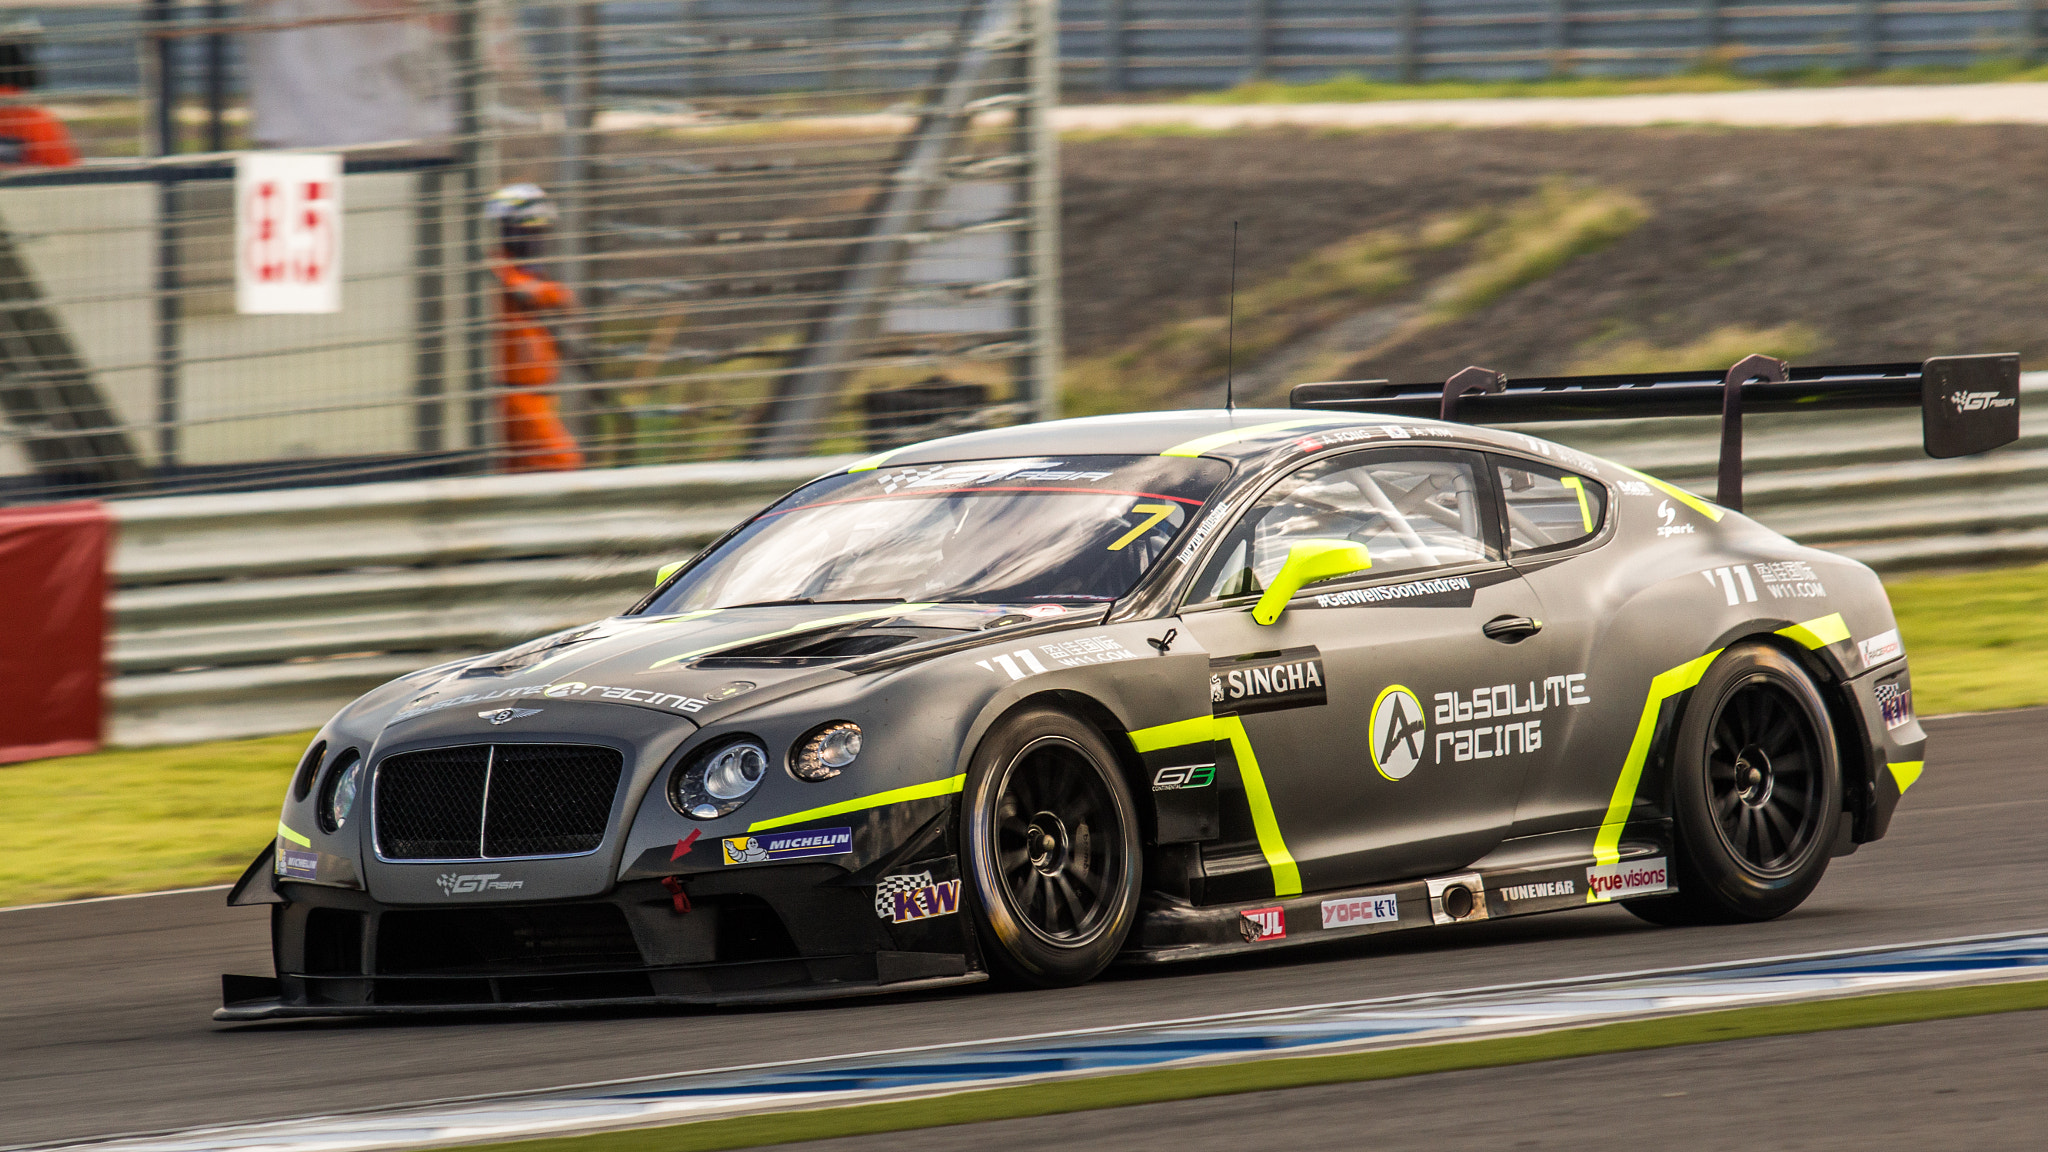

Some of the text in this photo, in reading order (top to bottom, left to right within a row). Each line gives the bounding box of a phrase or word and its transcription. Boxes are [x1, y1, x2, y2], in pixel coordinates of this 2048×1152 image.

[1963, 391, 2000, 411] GT
[904, 461, 1114, 489] GT ASIA
[1560, 476, 1594, 534] 7
[1107, 503, 1177, 551] 7
[1316, 576, 1471, 607] #GetWellSoonAndrew
[1766, 582, 1827, 599] W11.COM
[1228, 661, 1322, 699] SINGHA
[1153, 762, 1216, 789] GT3
[769, 833, 850, 850] MICHELIN
[452, 873, 524, 893] GT ASIA
[1500, 880, 1575, 902] TUNEWEAR
[1590, 868, 1666, 893] true visions
[893, 879, 961, 923] KW
[1322, 901, 1373, 924] YOFC
